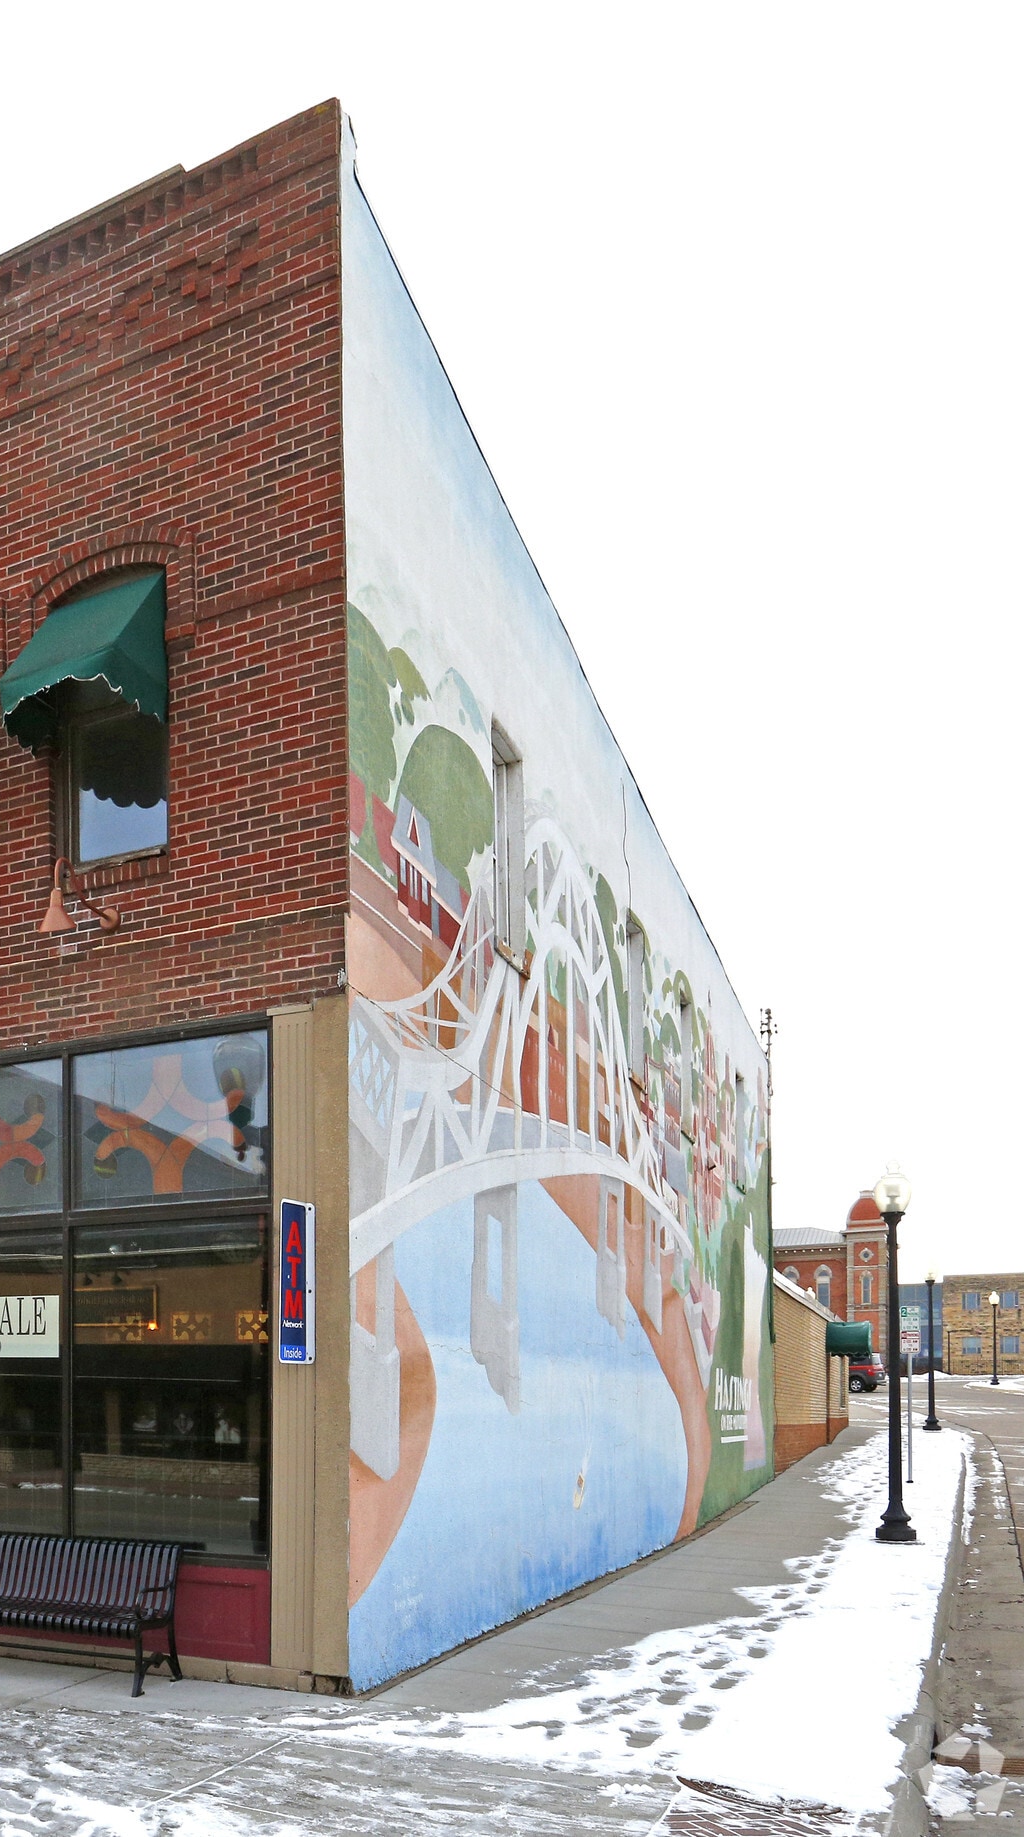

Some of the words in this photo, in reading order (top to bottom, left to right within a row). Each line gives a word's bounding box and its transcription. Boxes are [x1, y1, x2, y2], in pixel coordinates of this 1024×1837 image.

[284, 1220, 304, 1319] ATM
[282, 1320, 304, 1329] Network
[283, 1346, 303, 1359] Inside
